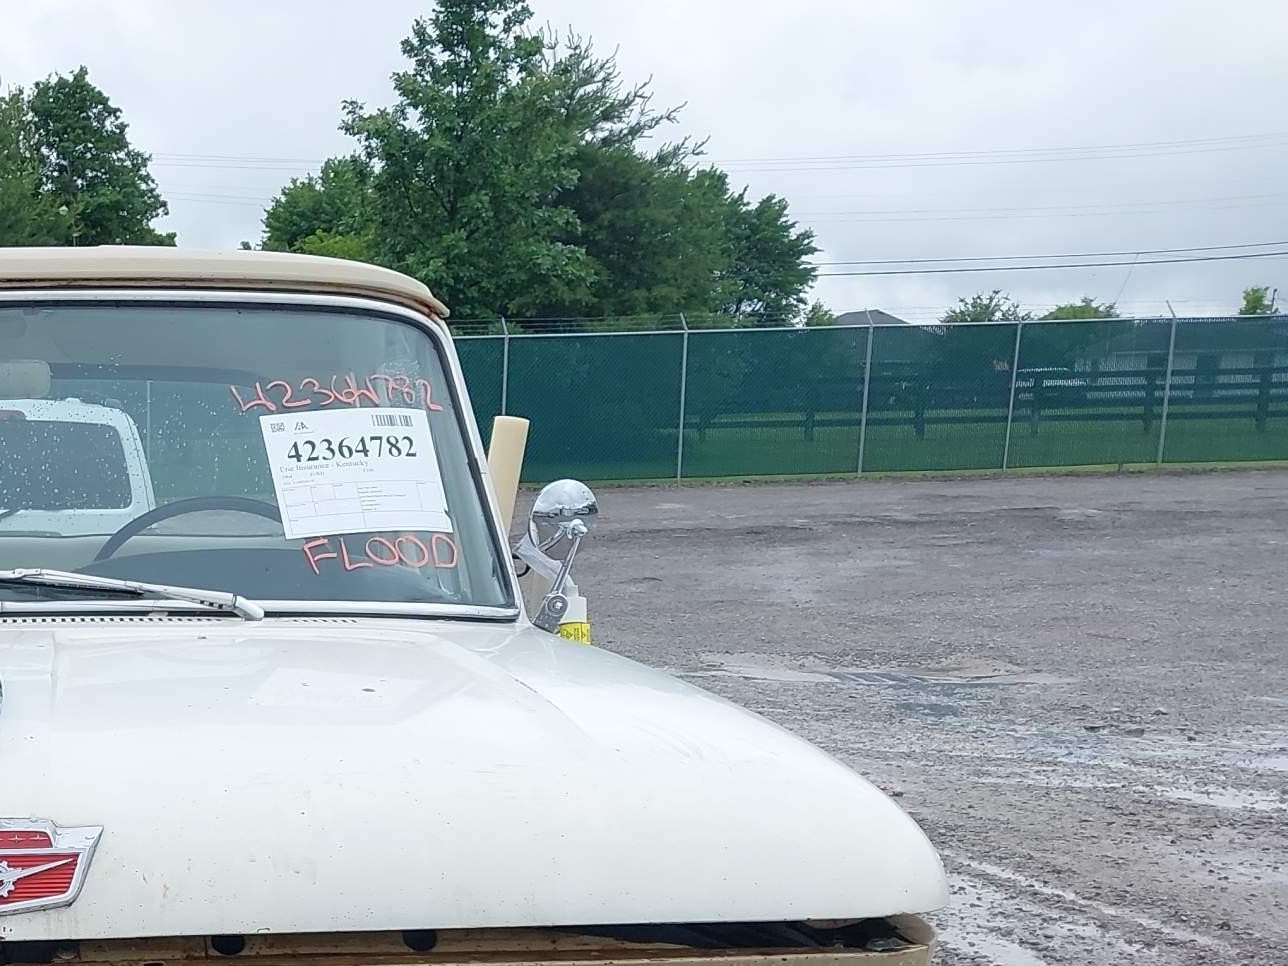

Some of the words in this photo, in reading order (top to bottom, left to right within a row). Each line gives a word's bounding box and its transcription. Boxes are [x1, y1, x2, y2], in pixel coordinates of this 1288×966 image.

[229, 372, 443, 411] 42364782
[287, 435, 417, 463] 42364782
[336, 459, 368, 468] Kentucky
[303, 533, 458, 575] FLOOD
